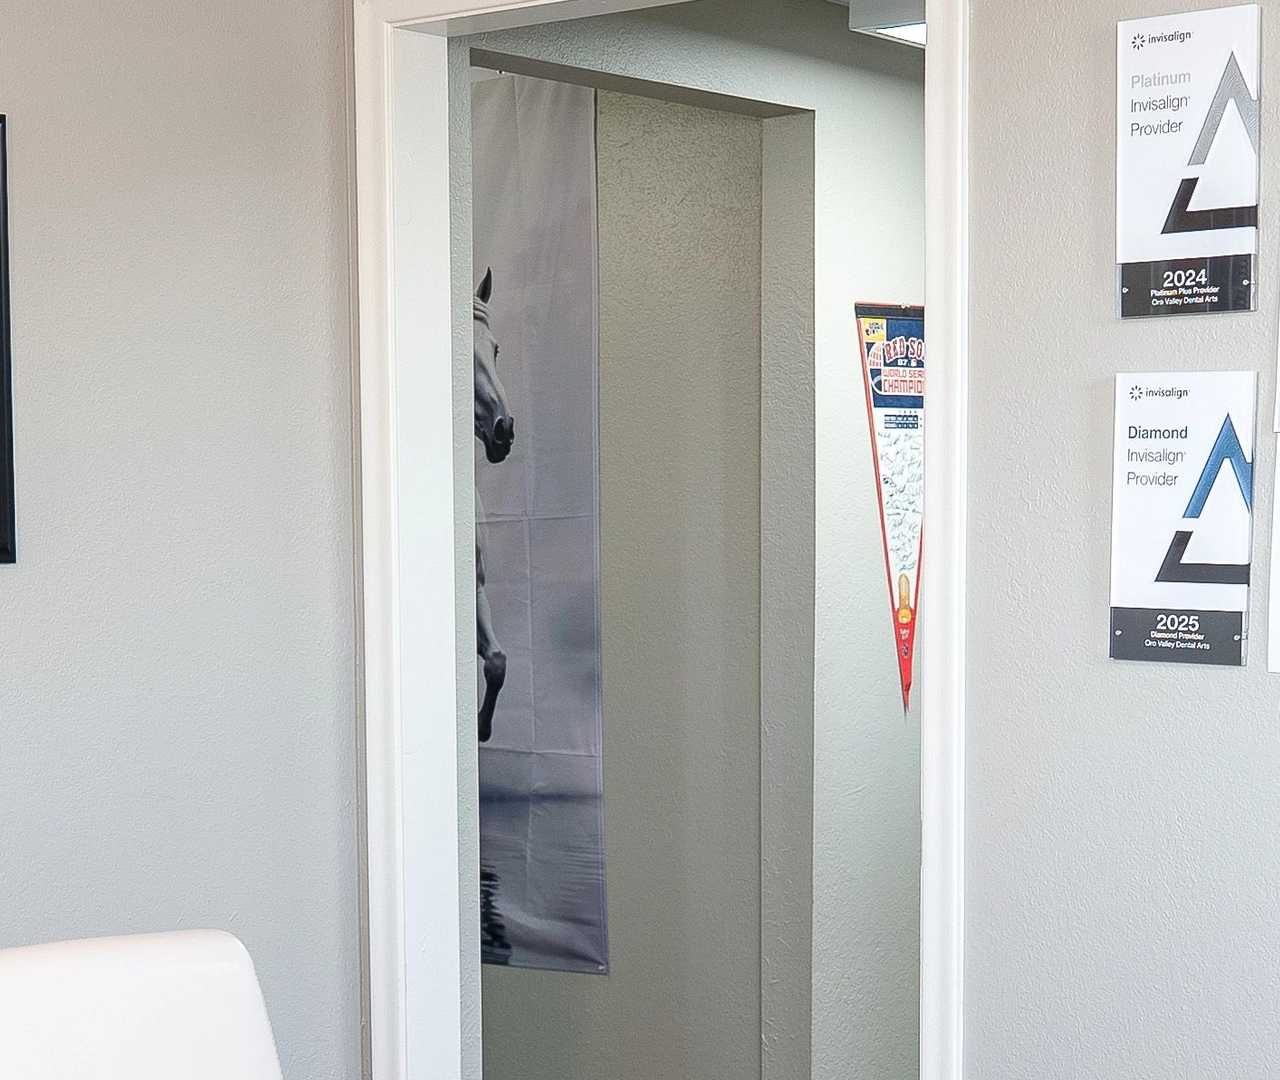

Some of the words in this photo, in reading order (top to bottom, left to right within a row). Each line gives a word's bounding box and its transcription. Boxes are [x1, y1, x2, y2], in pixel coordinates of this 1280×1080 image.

[1148, 31, 1192, 43] invisalign
[1131, 72, 1191, 89] Platinum
[1130, 119, 1183, 137] Provider
[1163, 269, 1207, 288] 2024
[1150, 289, 1178, 297] Platinum
[1178, 287, 1192, 295] Plus
[1193, 285, 1220, 295] Provider
[1151, 298, 1164, 306] Oro
[1164, 297, 1183, 306] Valley
[1183, 296, 1204, 304] Dental
[1205, 295, 1218, 303] Arts
[884, 337, 906, 361] RED
[909, 338, 924, 361] SO
[883, 369, 907, 378] WORLD
[908, 369, 924, 378] SER
[883, 379, 924, 393] CHAMPIO
[1146, 387, 1189, 400] invisalign
[1128, 425, 1188, 439] Diamond
[1126, 471, 1178, 486] Provider
[1156, 614, 1200, 632] 2025
[1150, 631, 1177, 639] Diamond
[1179, 632, 1205, 640] Provider
[1144, 639, 1157, 647] Oro
[1157, 640, 1175, 649] Valley
[1175, 641, 1196, 649] Dental
[1196, 642, 1210, 650] Arts
